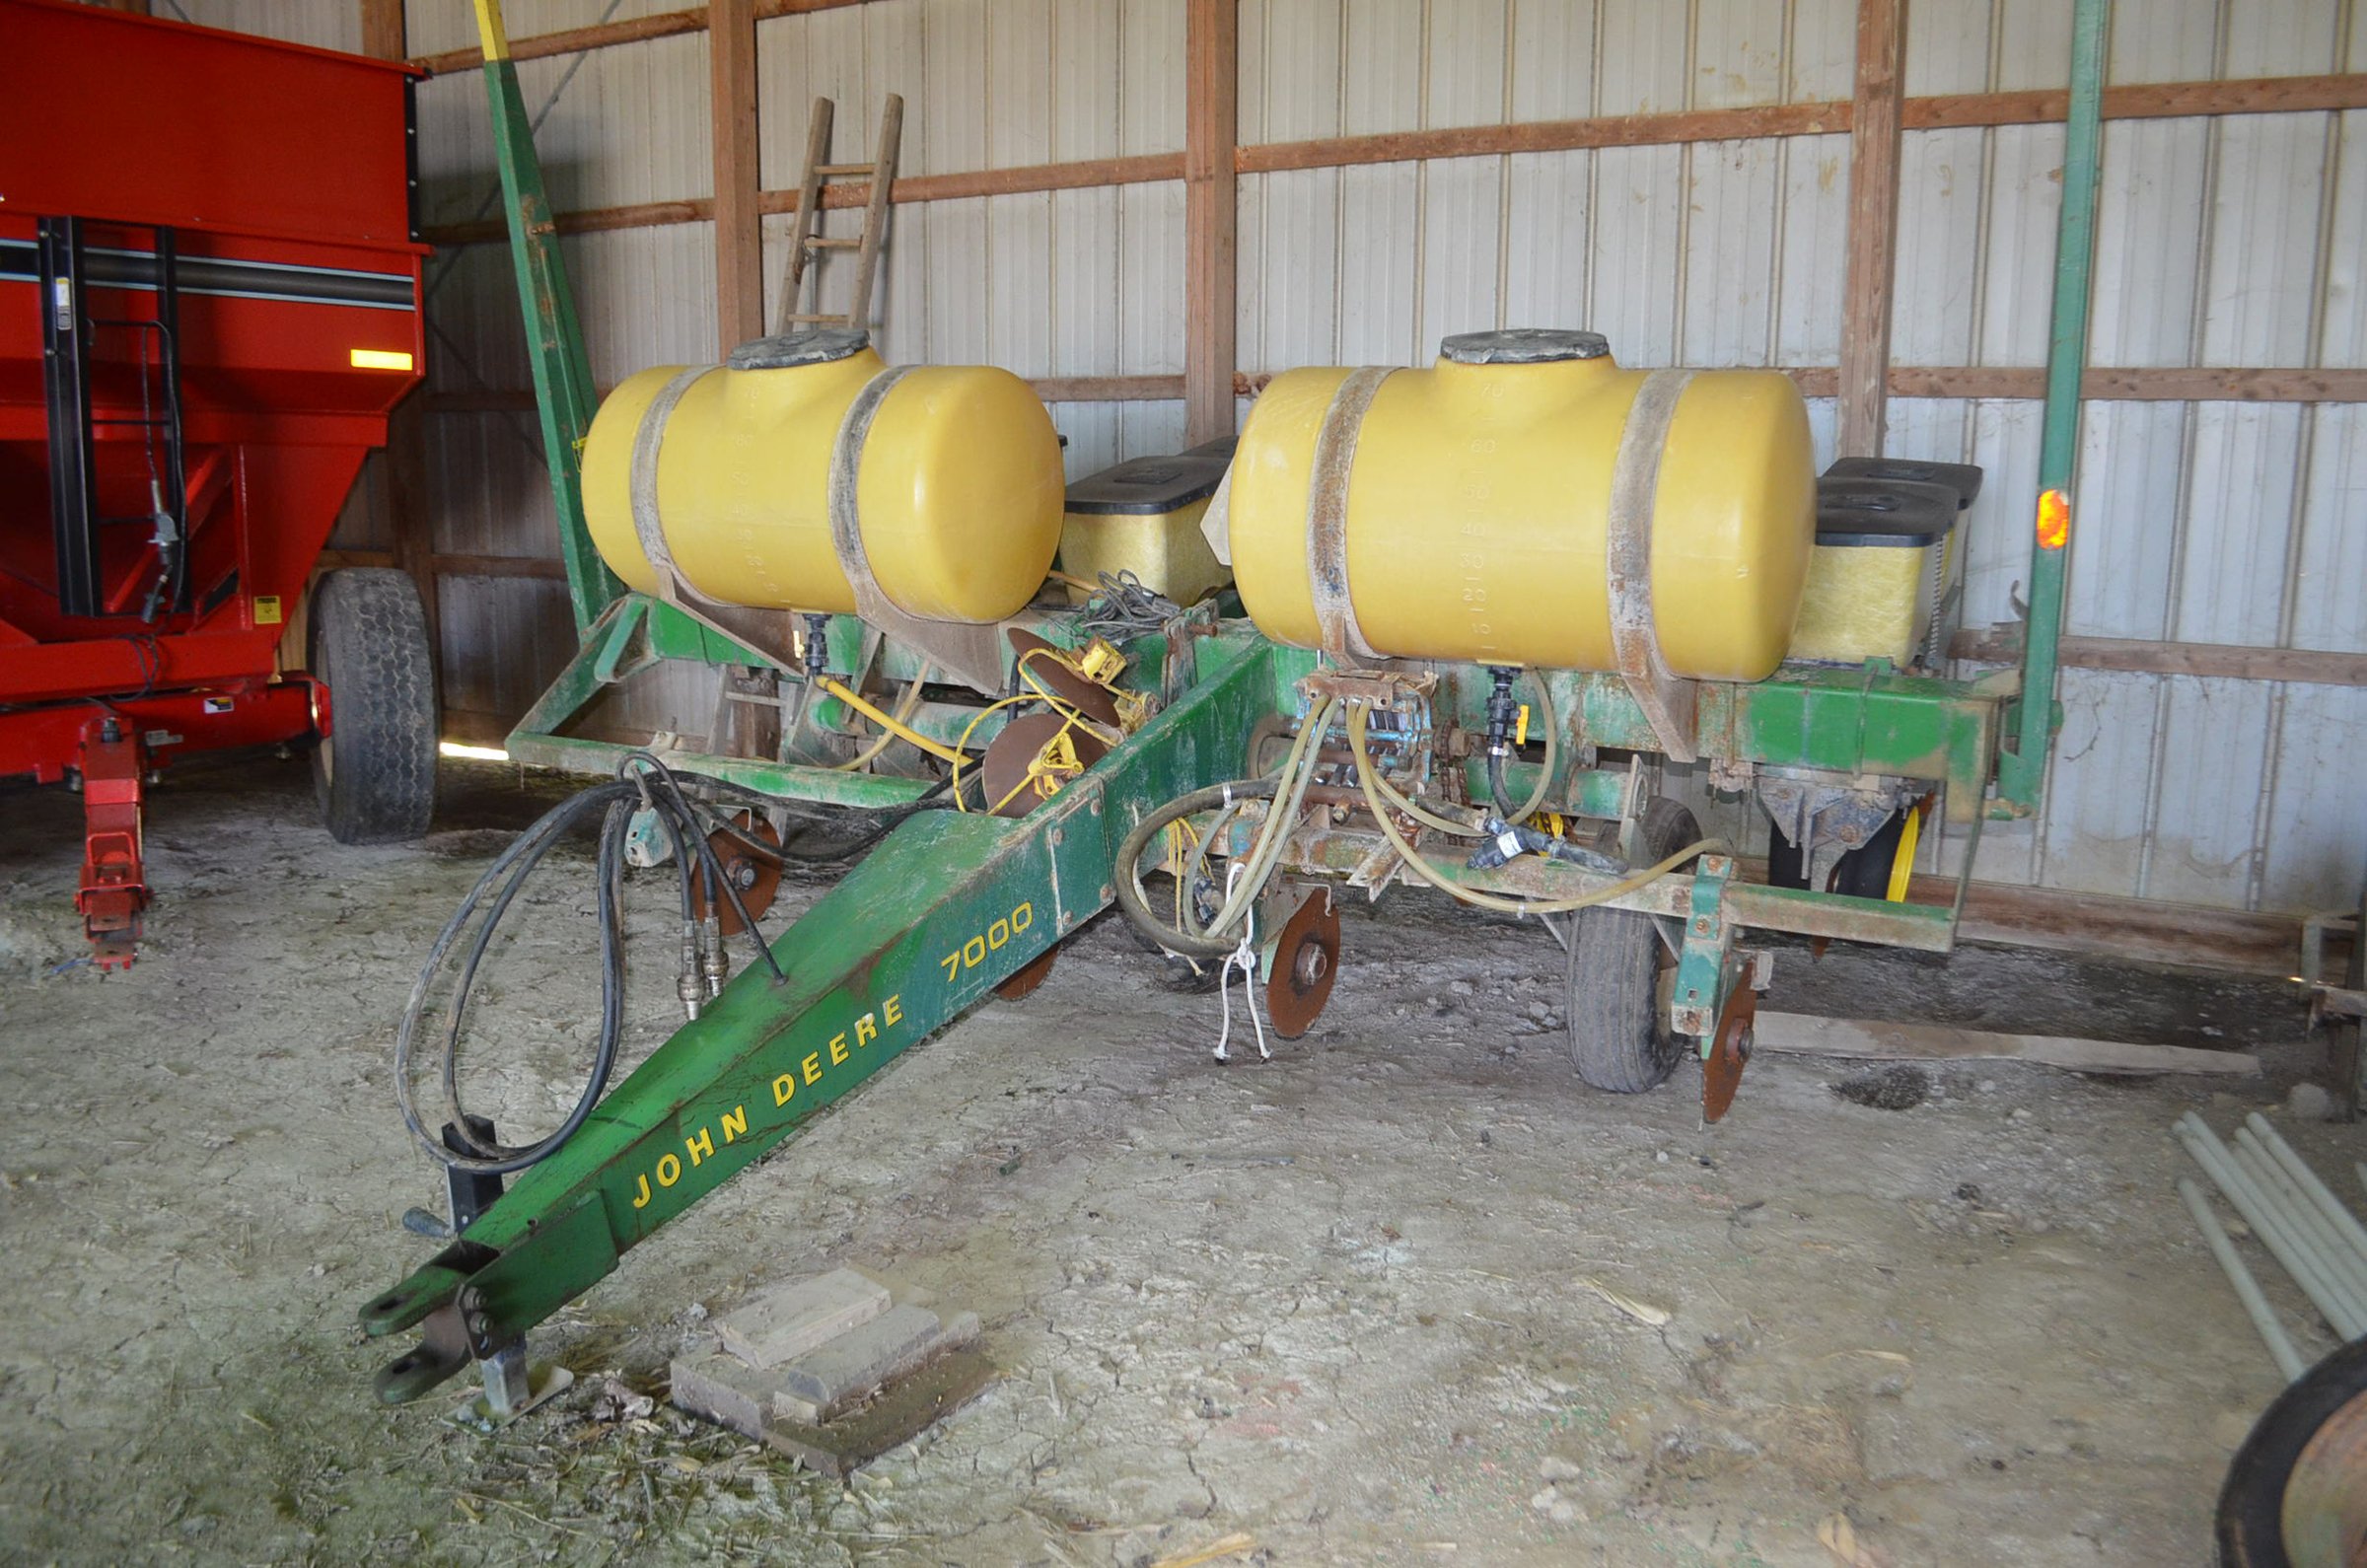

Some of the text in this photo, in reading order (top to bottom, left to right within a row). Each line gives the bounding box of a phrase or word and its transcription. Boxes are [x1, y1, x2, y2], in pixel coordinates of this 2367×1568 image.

[631, 899, 1035, 1210] JOHN DEERE 7000
